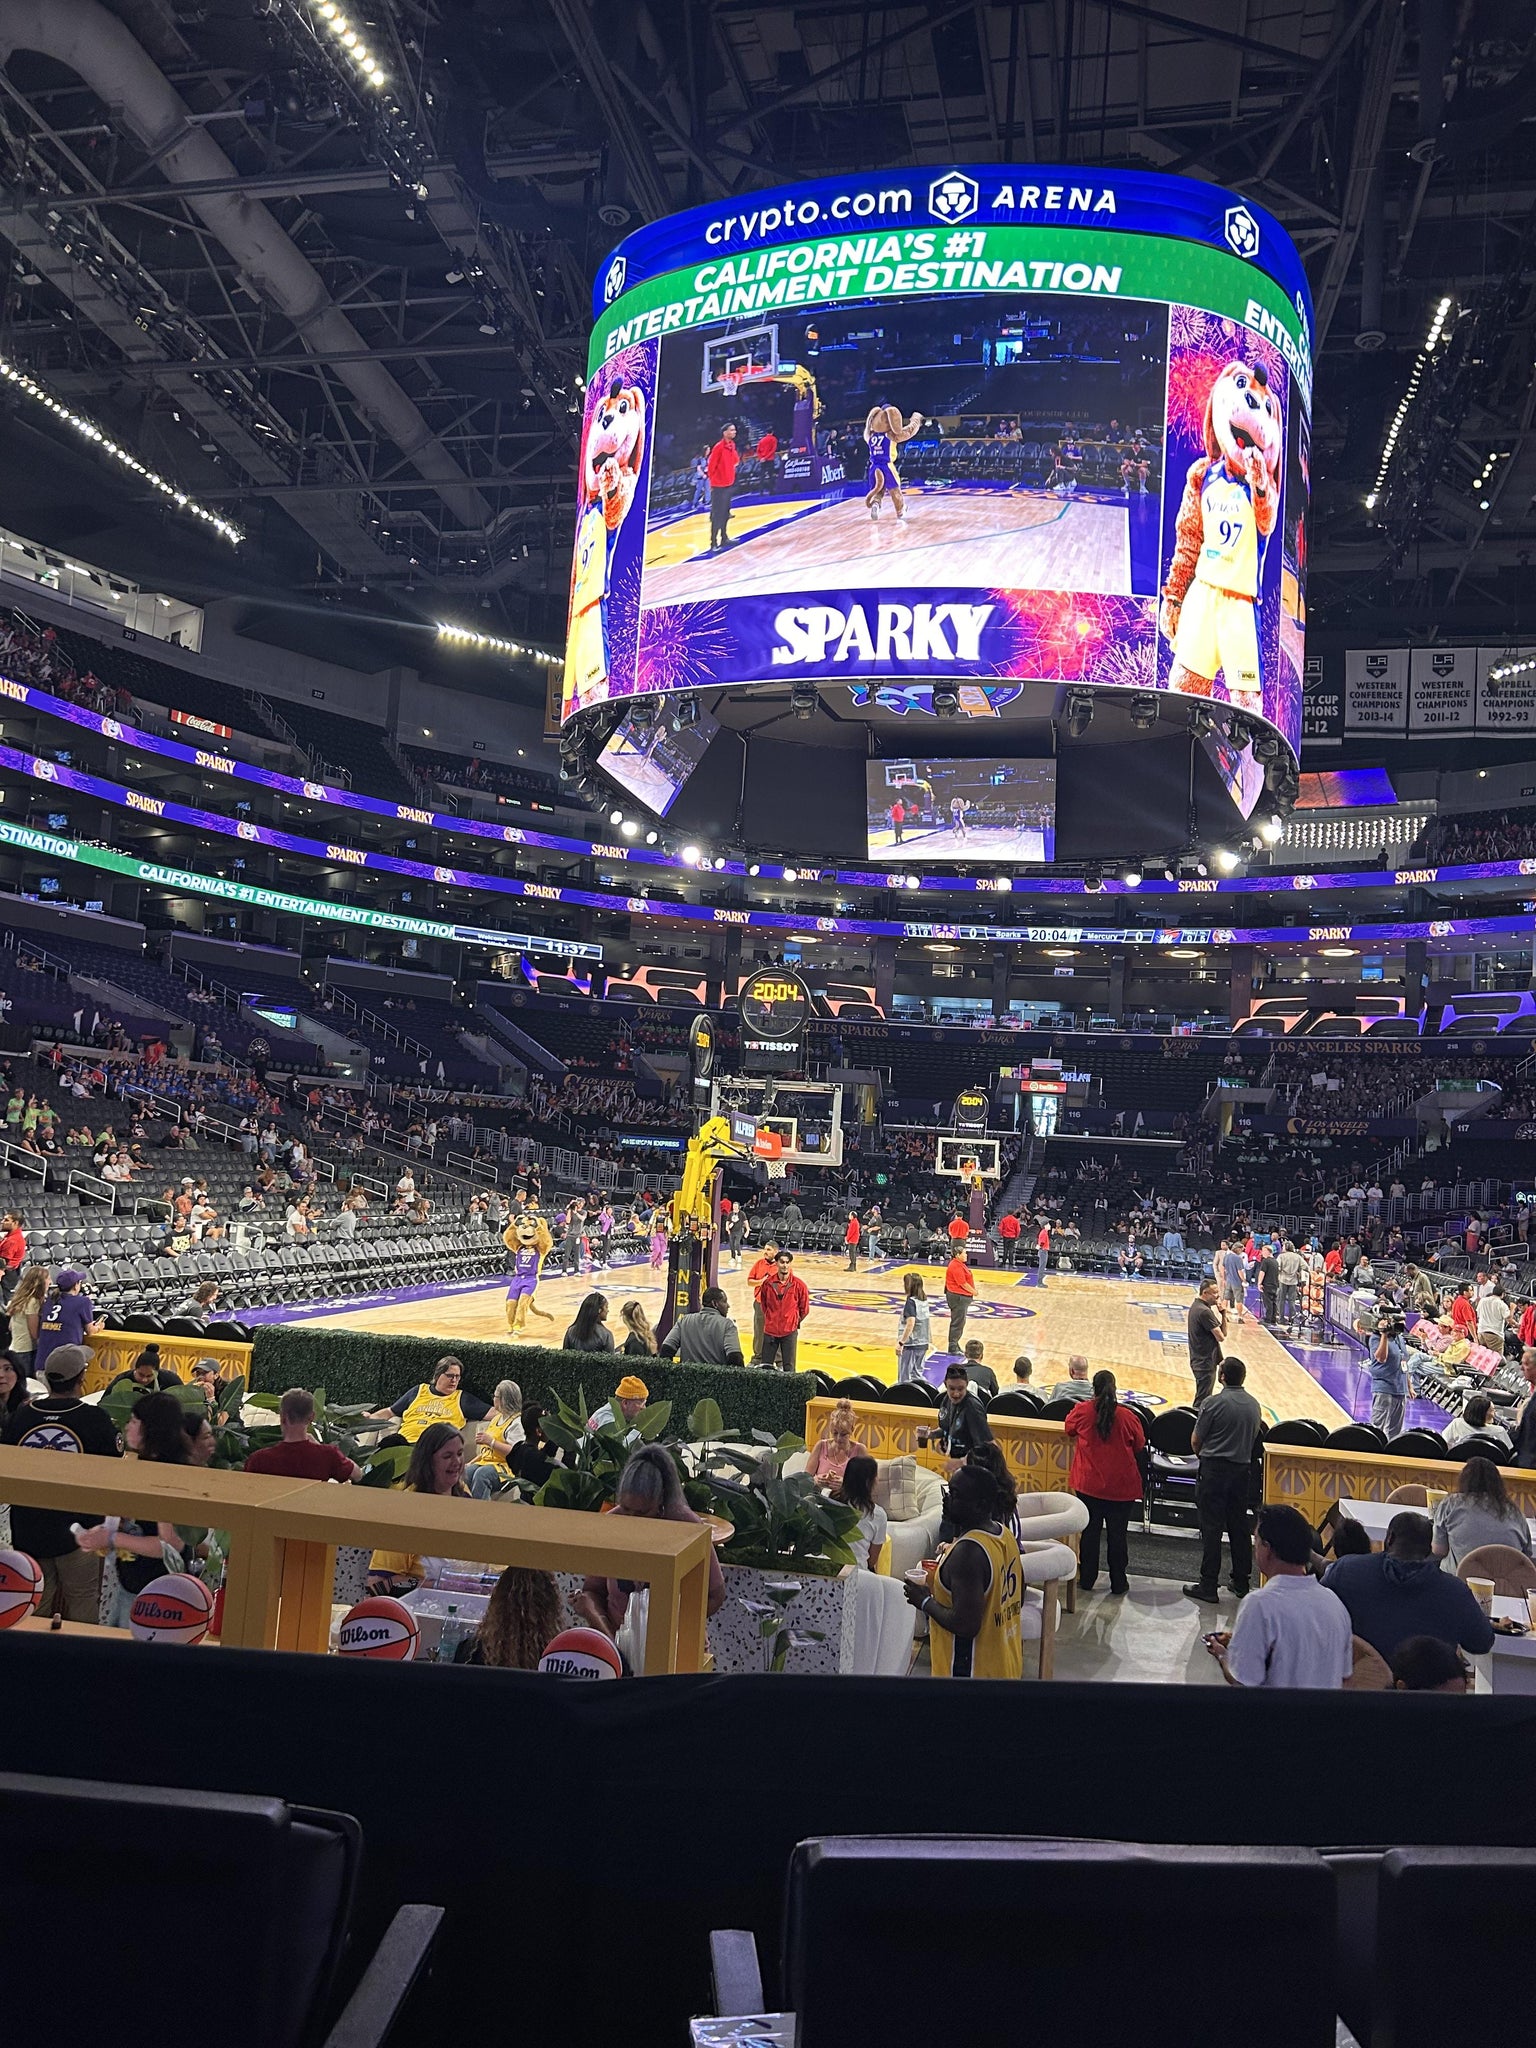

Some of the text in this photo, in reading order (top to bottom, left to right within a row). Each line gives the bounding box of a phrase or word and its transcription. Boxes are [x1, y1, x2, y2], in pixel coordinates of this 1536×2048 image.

[705, 185, 1117, 244] crypto.com ARENA
[694, 231, 987, 293] CALIFORNIA'S #1
[604, 260, 1123, 359] ENTERTAINMENT DESTINATION
[870, 435, 885, 447] 97
[820, 463, 846, 485] Albert
[1219, 520, 1243, 547] 97
[771, 603, 997, 665] SPARKY
[1367, 656, 1388, 666] LA
[1433, 655, 1454, 664] LA
[1356, 681, 1397, 690] WESTERN
[1421, 680, 1464, 689] WESTERN
[1317, 694, 1339, 705] CUP
[1349, 691, 1403, 700] CONFERENCE
[1414, 689, 1471, 699] CONFERENCE
[1352, 701, 1400, 709] CHAMPIONS
[1416, 700, 1468, 709] CHAMPIONS
[1483, 699, 1535, 708] CHAMPIONS
[1304, 705, 1339, 717] PIONS
[1357, 711, 1394, 722] 2013-14
[1423, 711, 1460, 722] 2011-12
[1488, 711, 1529, 722] 1992-93
[1304, 720, 1328, 733] 1-12
[194, 750, 237, 775] SPARKY
[125, 790, 165, 816] SPARKY
[396, 805, 435, 825] SPARKY
[0, 823, 79, 858] STINATION
[326, 845, 368, 865] SPARKY
[591, 843, 630, 860] SPARKY
[797, 868, 821, 881] RKY
[1394, 869, 1438, 884] SPARKY
[523, 883, 563, 901] SPARKY
[1177, 880, 1220, 892] SPARKY
[138, 864, 238, 897] CALIFORNIA'S
[238, 887, 254, 901] #1
[256, 891, 371, 923] ENTERTAINMENT
[713, 908, 751, 924] SPARKY
[477, 933, 508, 943] Welcome
[969, 928, 1144, 942] 0 Sparks 20:04 1 Mercury 0
[1308, 927, 1353, 940] SPARKY
[545, 941, 589, 956] 11:37
[753, 982, 799, 1002] 20:04
[809, 1022, 838, 1034] ELES
[840, 1024, 889, 1037] SPARKS
[759, 1041, 800, 1052] TISSOT
[1269, 1041, 1295, 1053] LOS
[1364, 1042, 1422, 1054] SPARKS
[374, 1056, 386, 1065] 114
[581, 1076, 637, 1088] LOS ANGELES
[887, 1099, 899, 1108] 115
[961, 1096, 983, 1106] 20:04
[1238, 1118, 1252, 1126] 116
[1307, 1120, 1370, 1129] LOS ANGELES
[1457, 1123, 1470, 1132] 117
[735, 1120, 755, 1138] ALFRED
[653, 1139, 680, 1148] EXPRESS
[521, 1255, 532, 1264] 97
[46, 1304, 62, 1322] 3
[134, 1600, 184, 1622] Wilson
[339, 1624, 391, 1645] Wilson
[545, 1658, 600, 1679] Wilson
